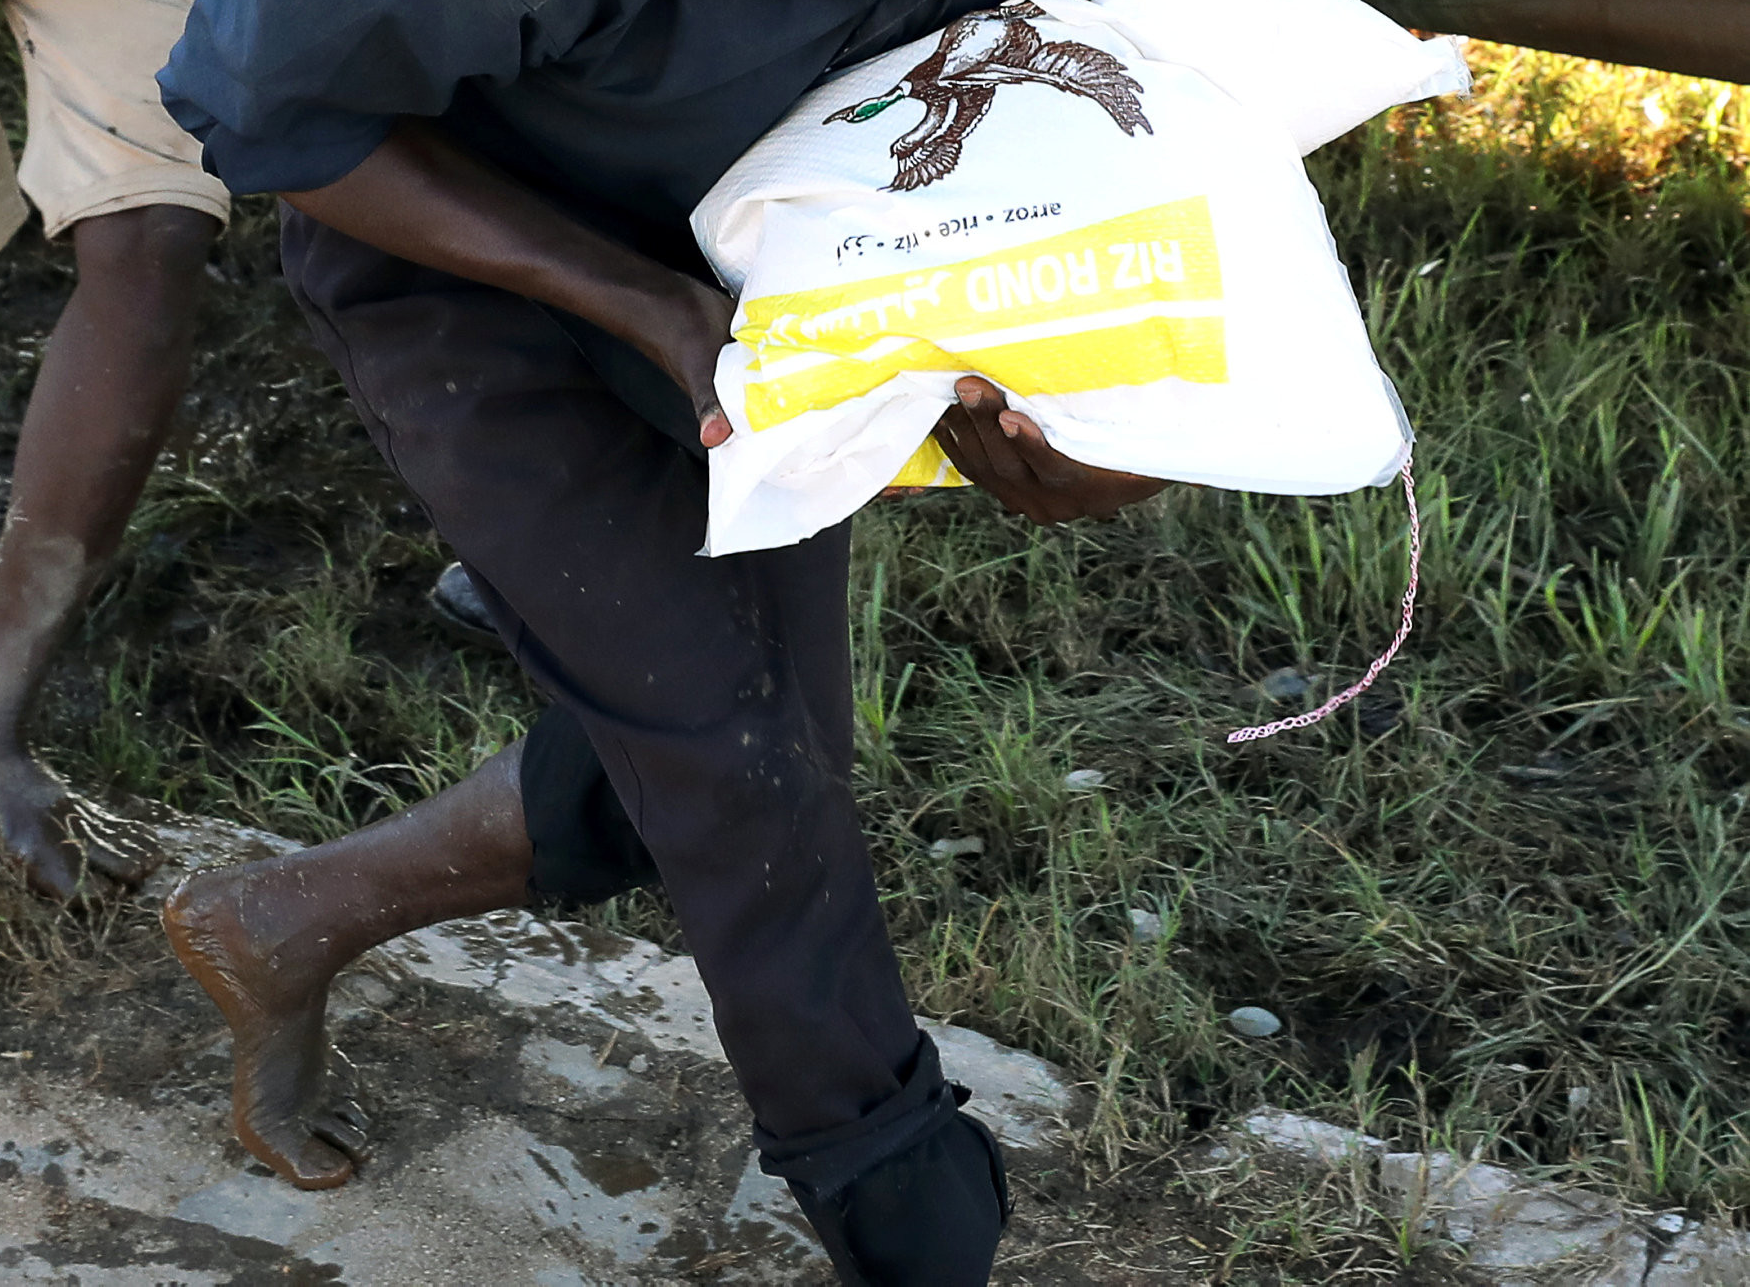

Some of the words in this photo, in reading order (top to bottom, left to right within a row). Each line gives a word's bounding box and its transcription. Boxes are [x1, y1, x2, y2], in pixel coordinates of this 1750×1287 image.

[1002, 202, 1062, 224] arroz
[938, 215, 979, 237] rice
[893, 231, 920, 254] riz
[1107, 240, 1185, 290] RIZ
[966, 248, 1100, 313] ROND
